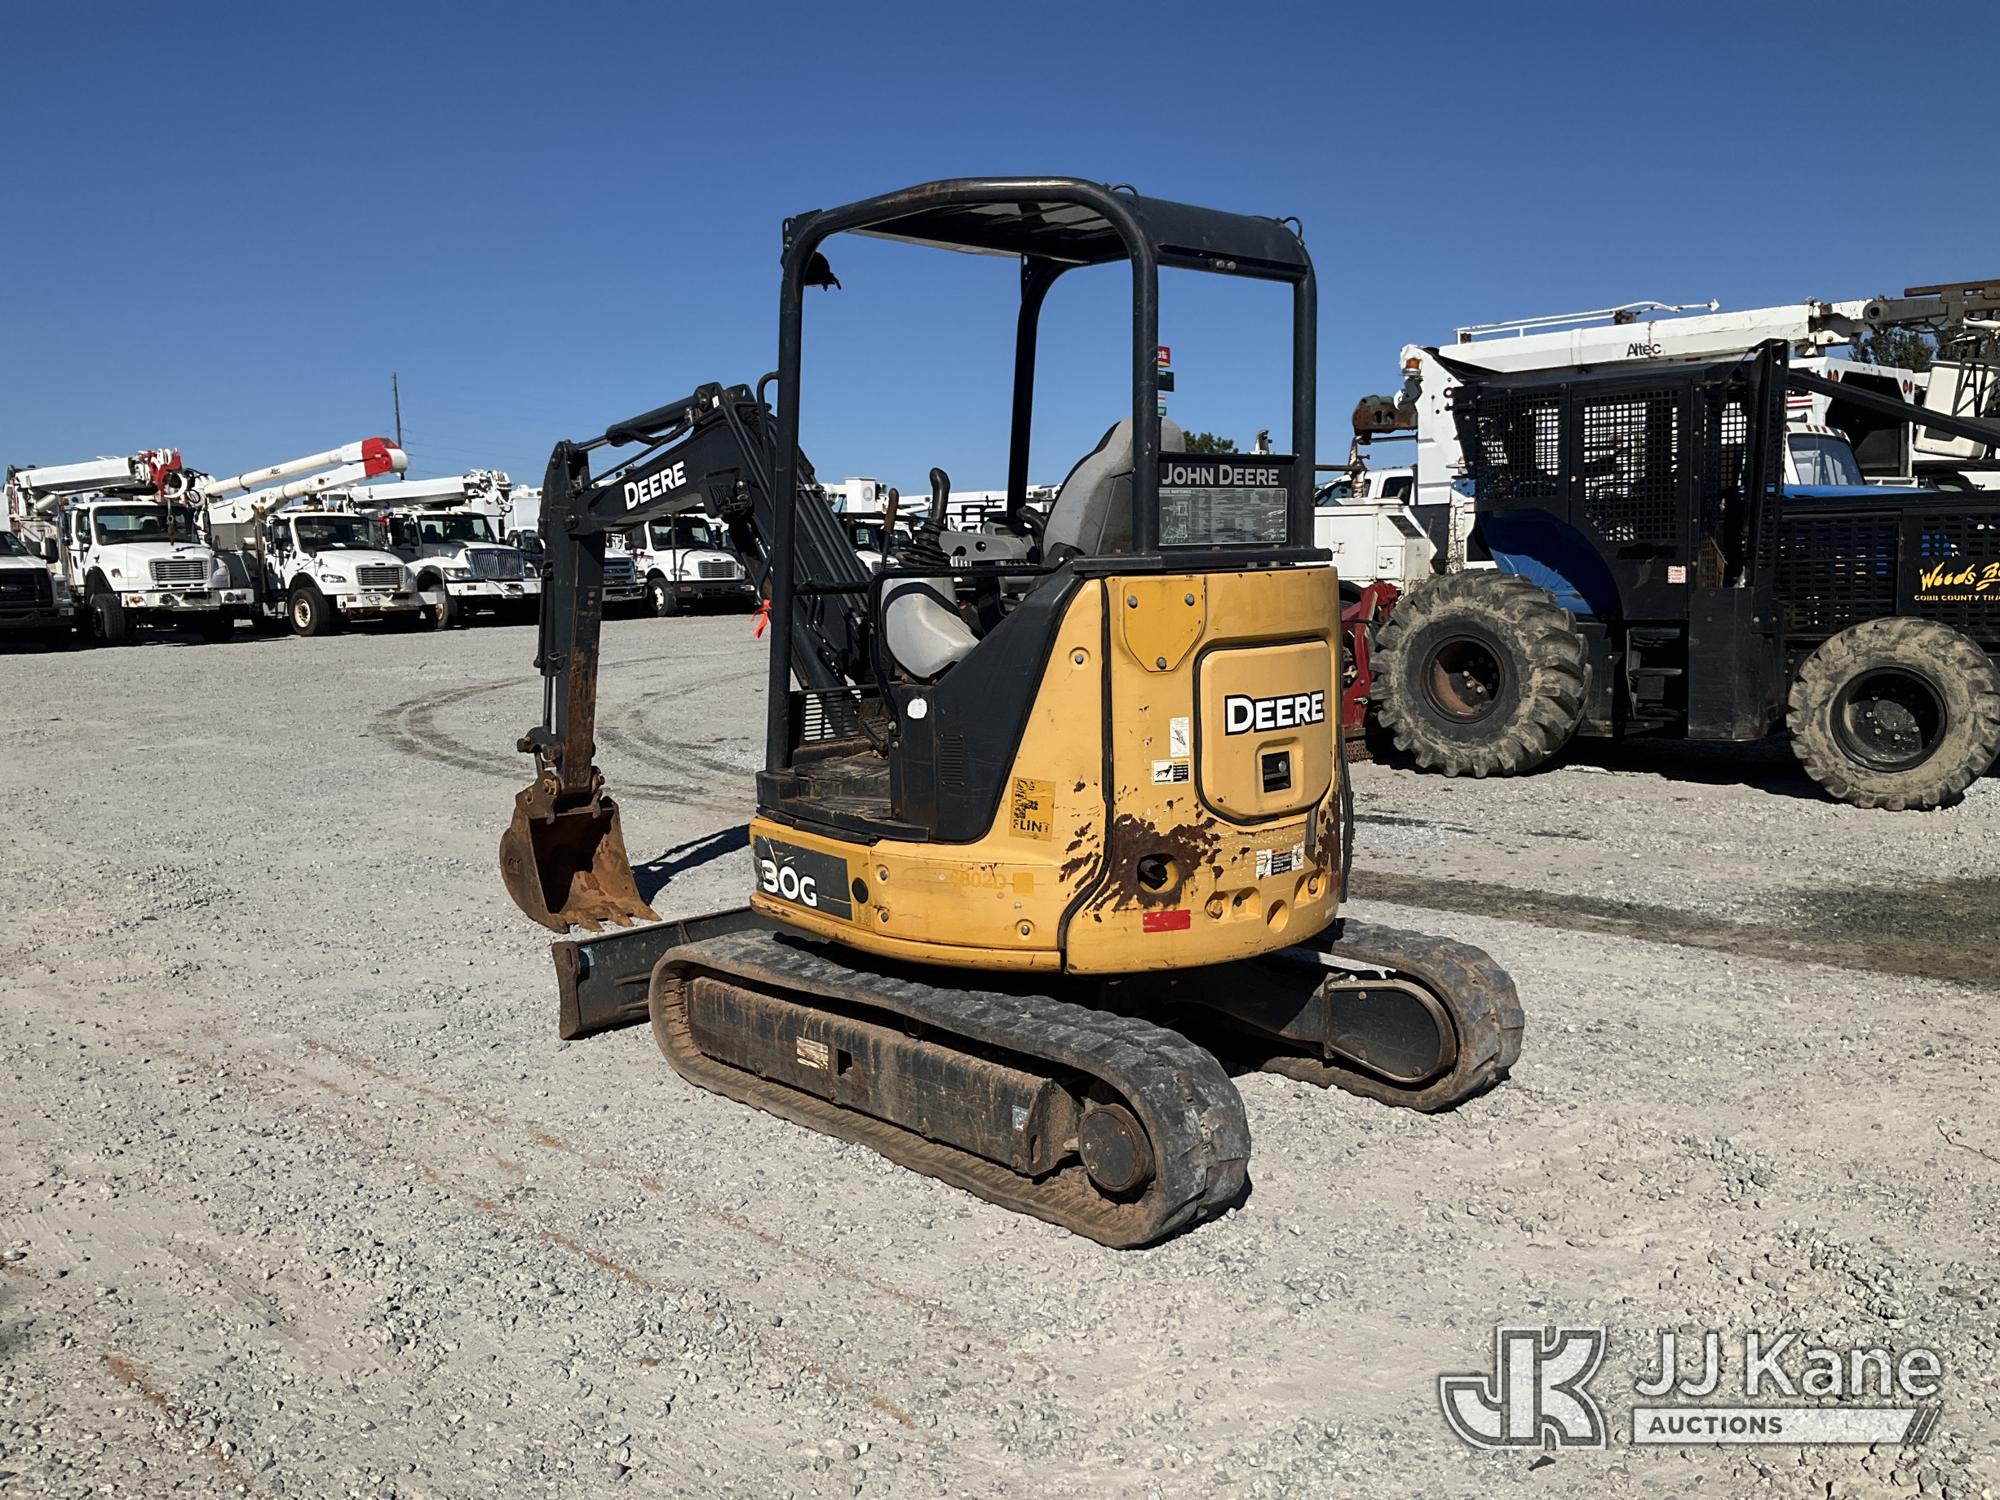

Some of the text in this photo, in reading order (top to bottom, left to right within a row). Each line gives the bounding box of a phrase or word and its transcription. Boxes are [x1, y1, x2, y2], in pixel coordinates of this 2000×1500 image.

[1626, 343, 1662, 357] Altec
[623, 460, 687, 511] DEERE
[1161, 463, 1280, 486] JOHN DEERE
[1919, 561, 1976, 592] Woods
[1225, 690, 1325, 735] DEERE
[761, 859, 818, 907] 30G
